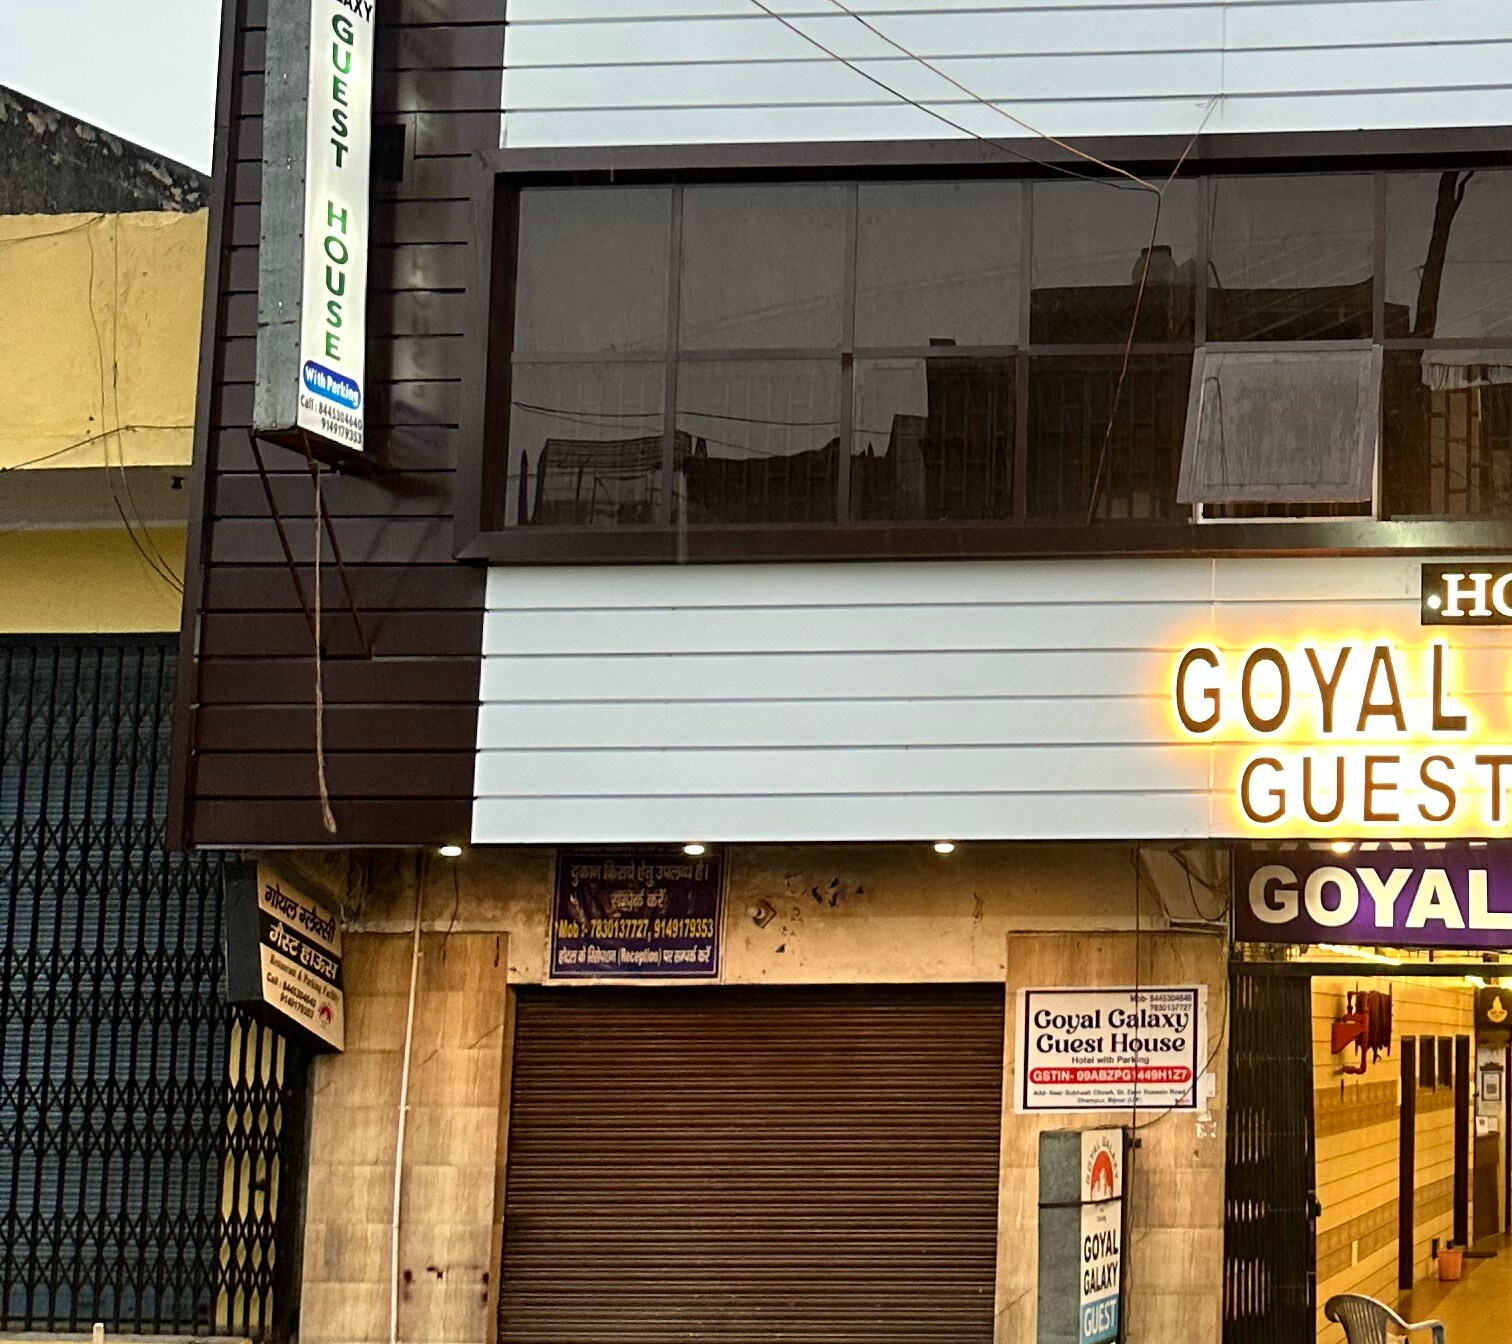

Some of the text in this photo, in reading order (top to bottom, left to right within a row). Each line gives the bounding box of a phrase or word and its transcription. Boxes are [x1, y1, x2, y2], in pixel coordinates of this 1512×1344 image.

[331, 14, 354, 168] GUEST
[324, 200, 349, 361] HOUSE
[300, 394, 313, 410] Call
[305, 366, 359, 407] With Parking
[1176, 644, 1467, 733] GOYAL
[264, 883, 298, 920] गोयल
[590, 918, 652, 942] 7830137727,
[654, 918, 714, 939] 9149179353
[1034, 1009, 1188, 1034] Goyal Galaxy
[1036, 1033, 1186, 1053] Guest House
[1033, 1070, 1074, 1082] GSTIN-
[1072, 1055, 1149, 1065] Hotel with Parking
[1084, 1229, 1118, 1262] GOYAL
[1084, 1261, 1117, 1295] GALAXY
[1084, 1299, 1116, 1337] GUEST
